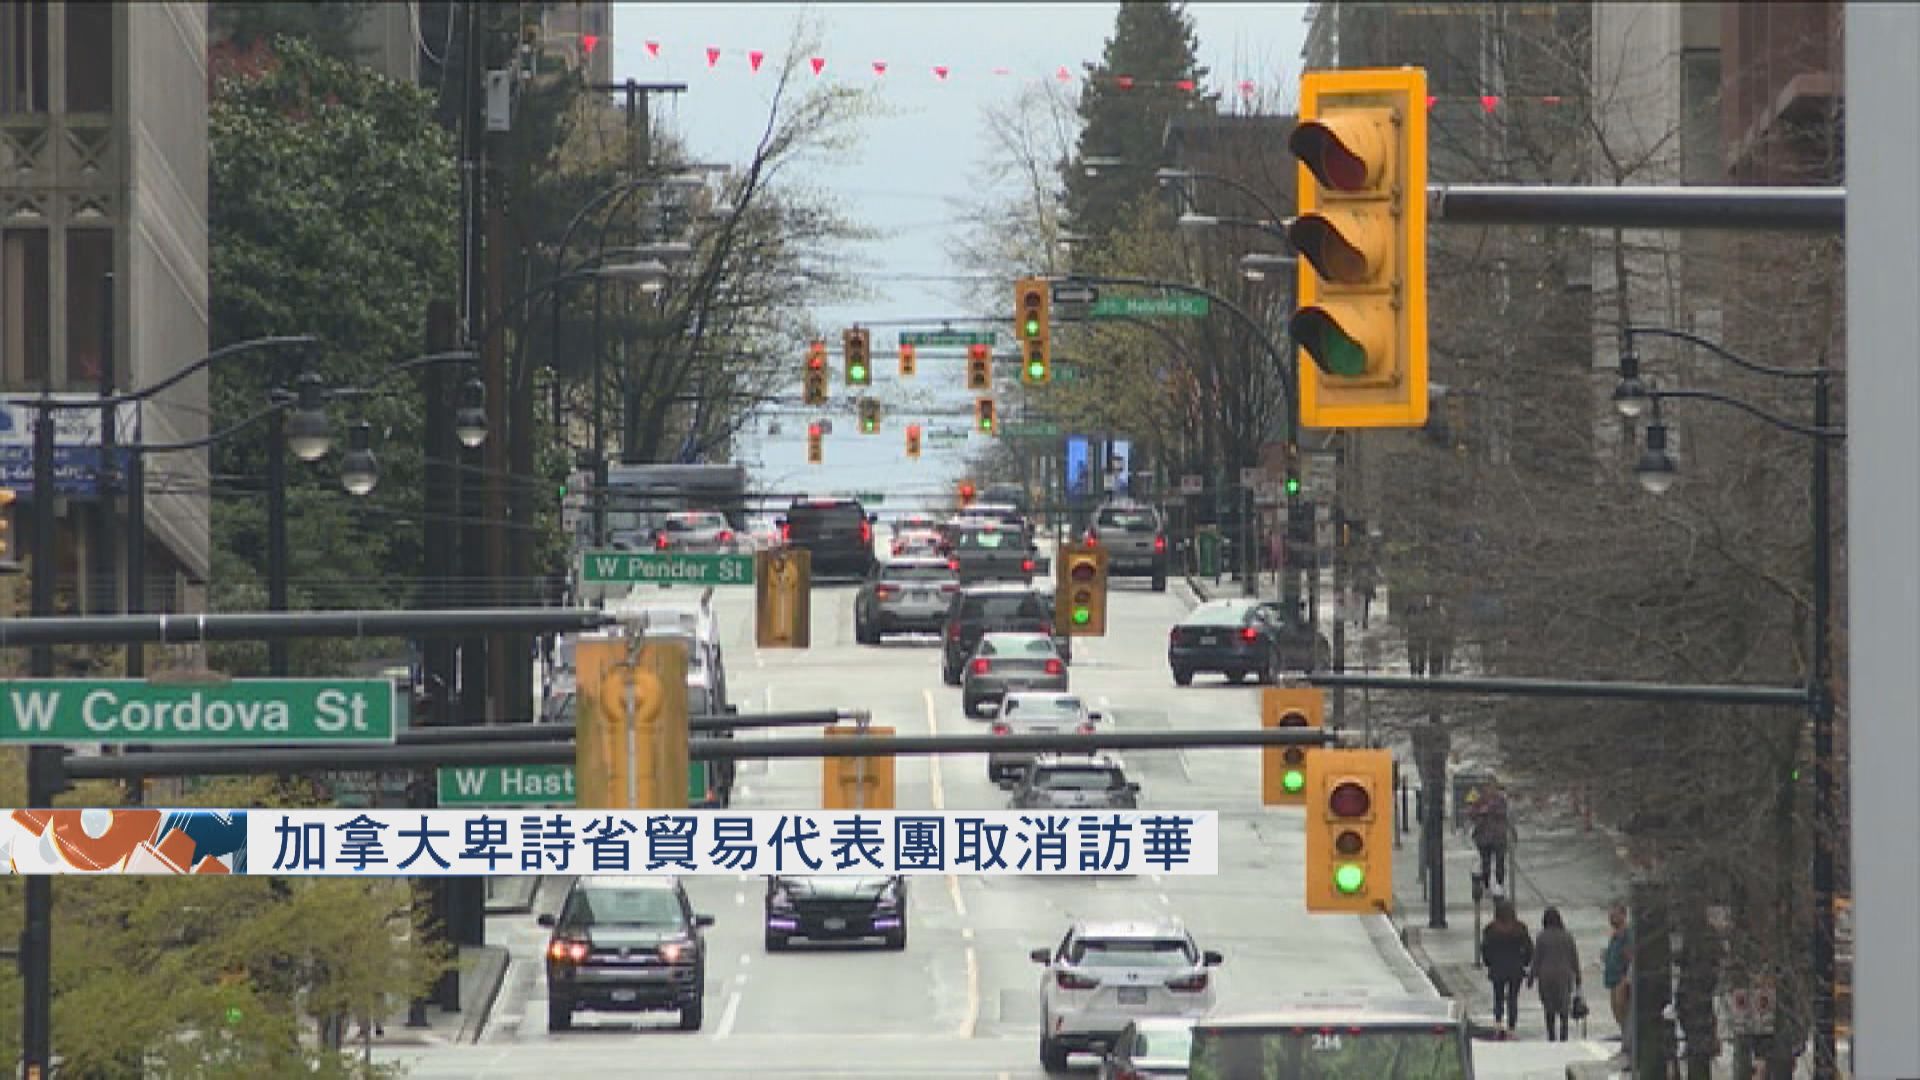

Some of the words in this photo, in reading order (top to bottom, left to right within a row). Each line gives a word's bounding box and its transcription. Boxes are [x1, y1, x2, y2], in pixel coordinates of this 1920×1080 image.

[596, 557, 620, 577] W
[628, 557, 708, 577] Pender
[720, 557, 745, 581] St
[11, 691, 60, 731] W
[82, 689, 289, 732] Cordova
[314, 689, 369, 732] St
[456, 768, 487, 795] W
[500, 768, 576, 795] Hast
